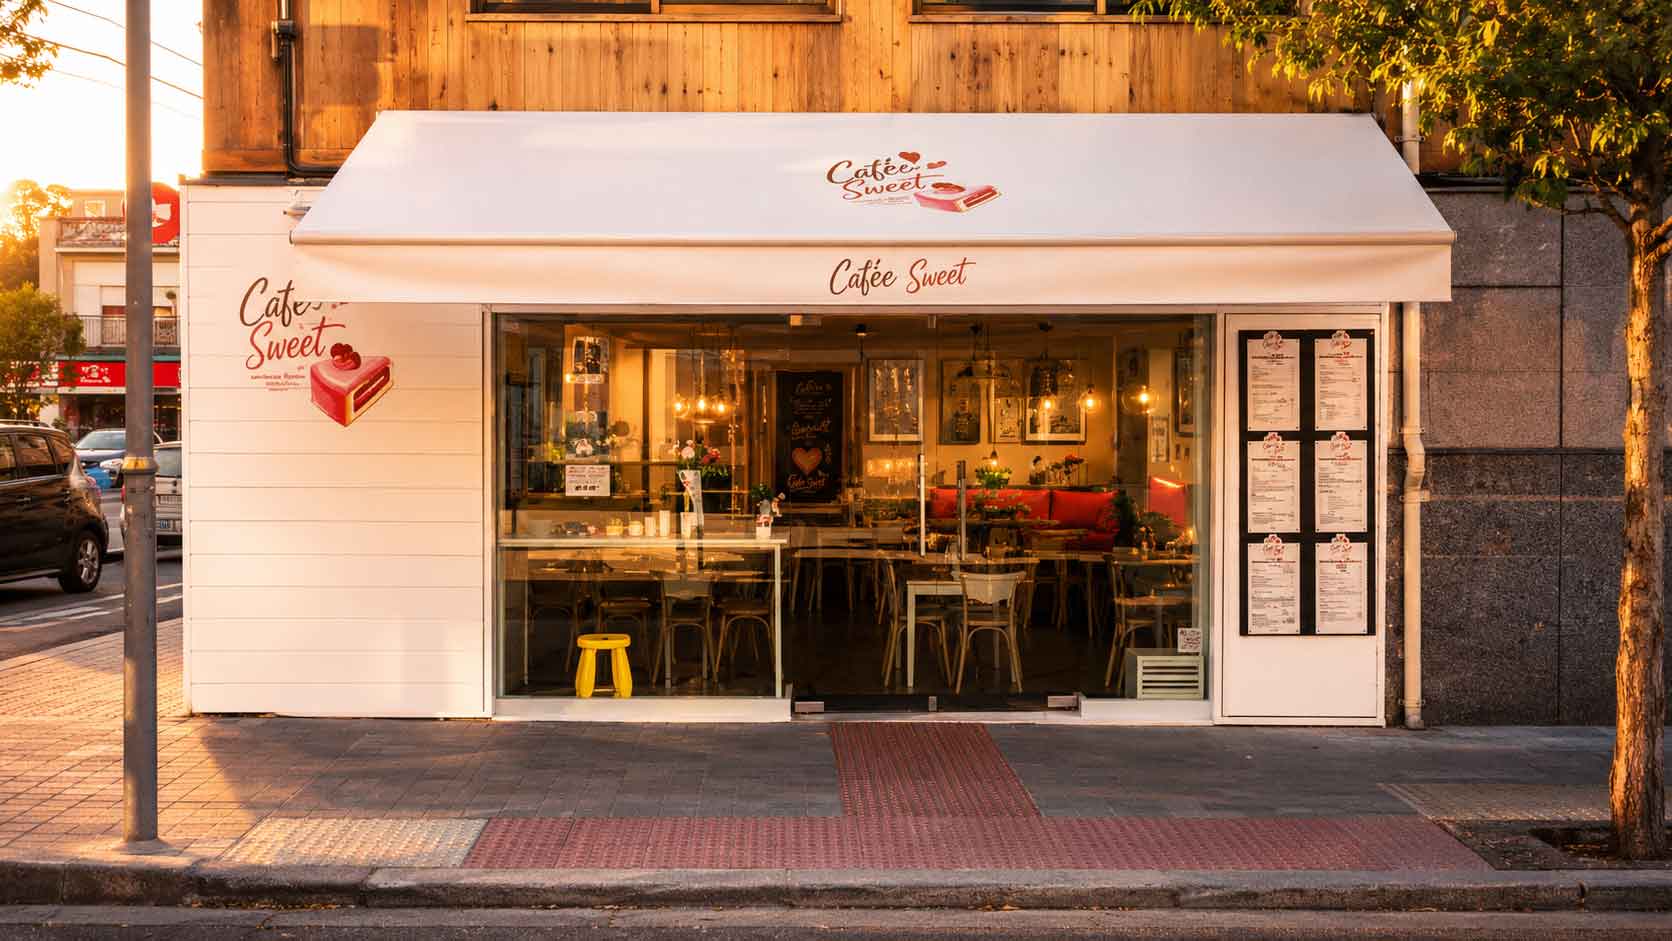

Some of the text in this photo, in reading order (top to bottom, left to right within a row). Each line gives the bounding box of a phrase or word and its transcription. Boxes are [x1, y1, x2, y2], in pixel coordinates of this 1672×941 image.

[826, 157, 918, 185] Cafée
[842, 173, 944, 201] Sweet
[829, 256, 977, 296] Cafée Sweet
[245, 316, 346, 370] Sweet
